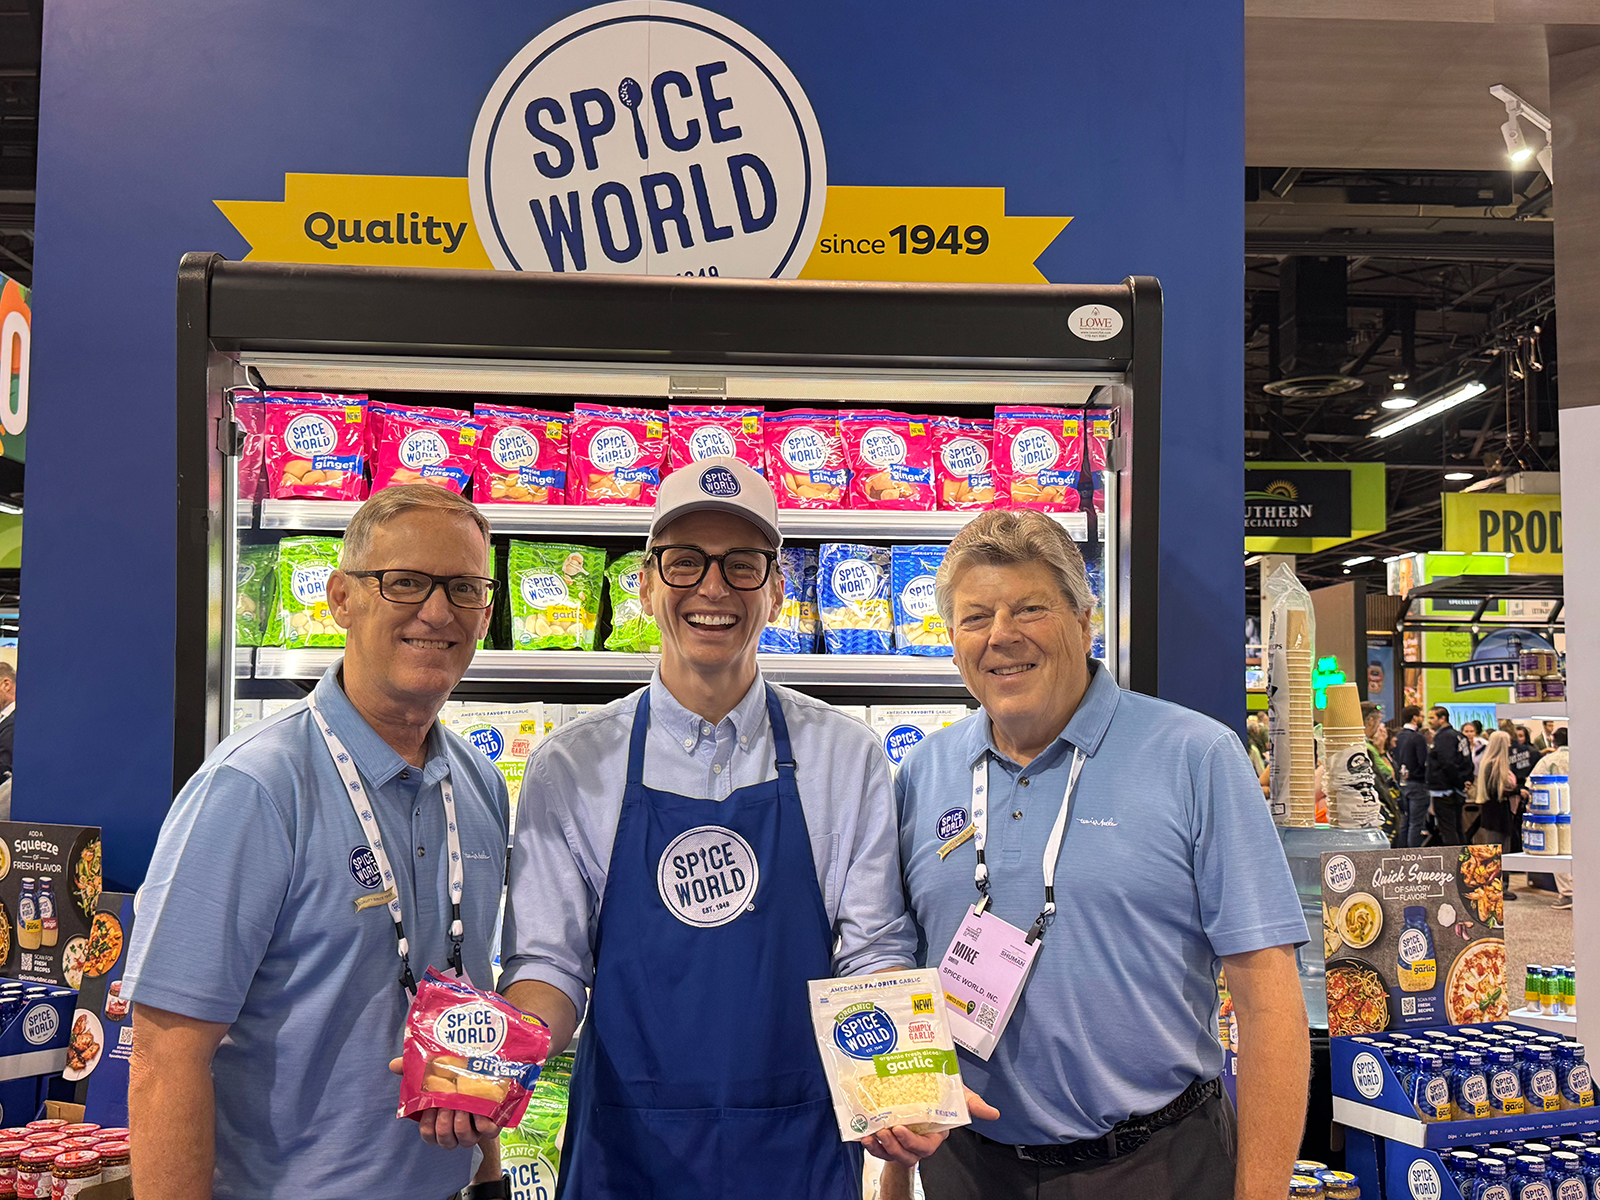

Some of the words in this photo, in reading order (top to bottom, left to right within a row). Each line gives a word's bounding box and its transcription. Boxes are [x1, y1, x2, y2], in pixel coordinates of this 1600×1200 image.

[525, 61, 742, 178] SPICE
[529, 153, 778, 273] WORLD
[303, 211, 468, 253] Quality
[820, 234, 885, 254] since
[888, 224, 990, 256] 1949
[1080, 317, 1112, 327] LOWE
[293, 422, 325, 440] SPICE
[294, 435, 331, 450] WORLD
[499, 435, 528, 451] SPICE
[696, 433, 724, 449] SPICE
[788, 435, 817, 450] SPICE
[1018, 435, 1047, 453] SPICE
[499, 445, 533, 463] WORLD
[949, 445, 977, 459] SPICE
[315, 460, 354, 470] ginger
[949, 454, 982, 469] WORLD
[522, 474, 555, 486] ginger
[705, 472, 731, 483] SPICE
[1040, 475, 1075, 485] ginger
[705, 480, 736, 491] WORLD
[838, 565, 867, 582] SPICE
[527, 576, 557, 589] SPICE
[553, 611, 583, 621] garlic
[1457, 663, 1519, 686] LITEH
[521, 723, 534, 733] NEW!
[470, 730, 494, 744] PICE
[889, 731, 918, 748] SPICE
[513, 741, 530, 749] SIMPLY
[941, 810, 963, 827] SPICE
[940, 819, 964, 836] WORLD
[14, 840, 59, 856] Squeeze
[13, 861, 34, 871] FRESH
[35, 862, 62, 873] FLAVOR
[353, 851, 375, 870] SPICE
[673, 842, 736, 879] SPICE
[1329, 861, 1348, 876] SPICE
[1372, 865, 1406, 888] Quick
[1407, 863, 1454, 886] Squeeze
[1330, 870, 1352, 885] WORLD
[675, 867, 746, 908] WORLD
[1404, 885, 1431, 893] SAVORY
[1399, 893, 1427, 901] FLAVOR!
[702, 905, 715, 914] EST.
[715, 901, 730, 912] 1949
[1402, 934, 1420, 948] SPICE
[952, 940, 980, 965] MIKE
[1403, 943, 1424, 957] WORLD
[1000, 950, 1026, 967] SHUMAN
[1414, 965, 1435, 975] garlic
[830, 984, 863, 993] AMERICA'S
[864, 980, 897, 989] FAVORITE
[899, 977, 921, 985] GARLIC
[942, 966, 962, 981] SPICE
[961, 977, 985, 996] WORLD,
[985, 992, 999, 1004] INC.
[838, 1003, 871, 1020] ORGANIC
[913, 999, 933, 1012] NEW!
[29, 1009, 51, 1027] SPICE
[447, 1010, 492, 1028] SPICE
[841, 1013, 880, 1038] SPICE
[29, 1019, 54, 1037] WORLD
[908, 1023, 932, 1032] SIMPLY
[445, 1027, 496, 1044] WORLD
[845, 1028, 891, 1052] WORLD
[909, 1031, 935, 1040] GARLIC
[887, 1056, 934, 1074] garlic
[1357, 1061, 1376, 1074] SPICE
[547, 1077, 569, 1086] GARLIC
[1357, 1073, 1380, 1086] WORLD
[1495, 1076, 1513, 1088] SPICE
[1572, 1070, 1588, 1081] SPICE
[1495, 1083, 1517, 1096] WORLD
[1412, 1169, 1433, 1182] SPICE
[1413, 1182, 1437, 1195] WORLD
[1525, 1187, 1546, 1199] SPICE
[1561, 1183, 1580, 1194] SPICE
